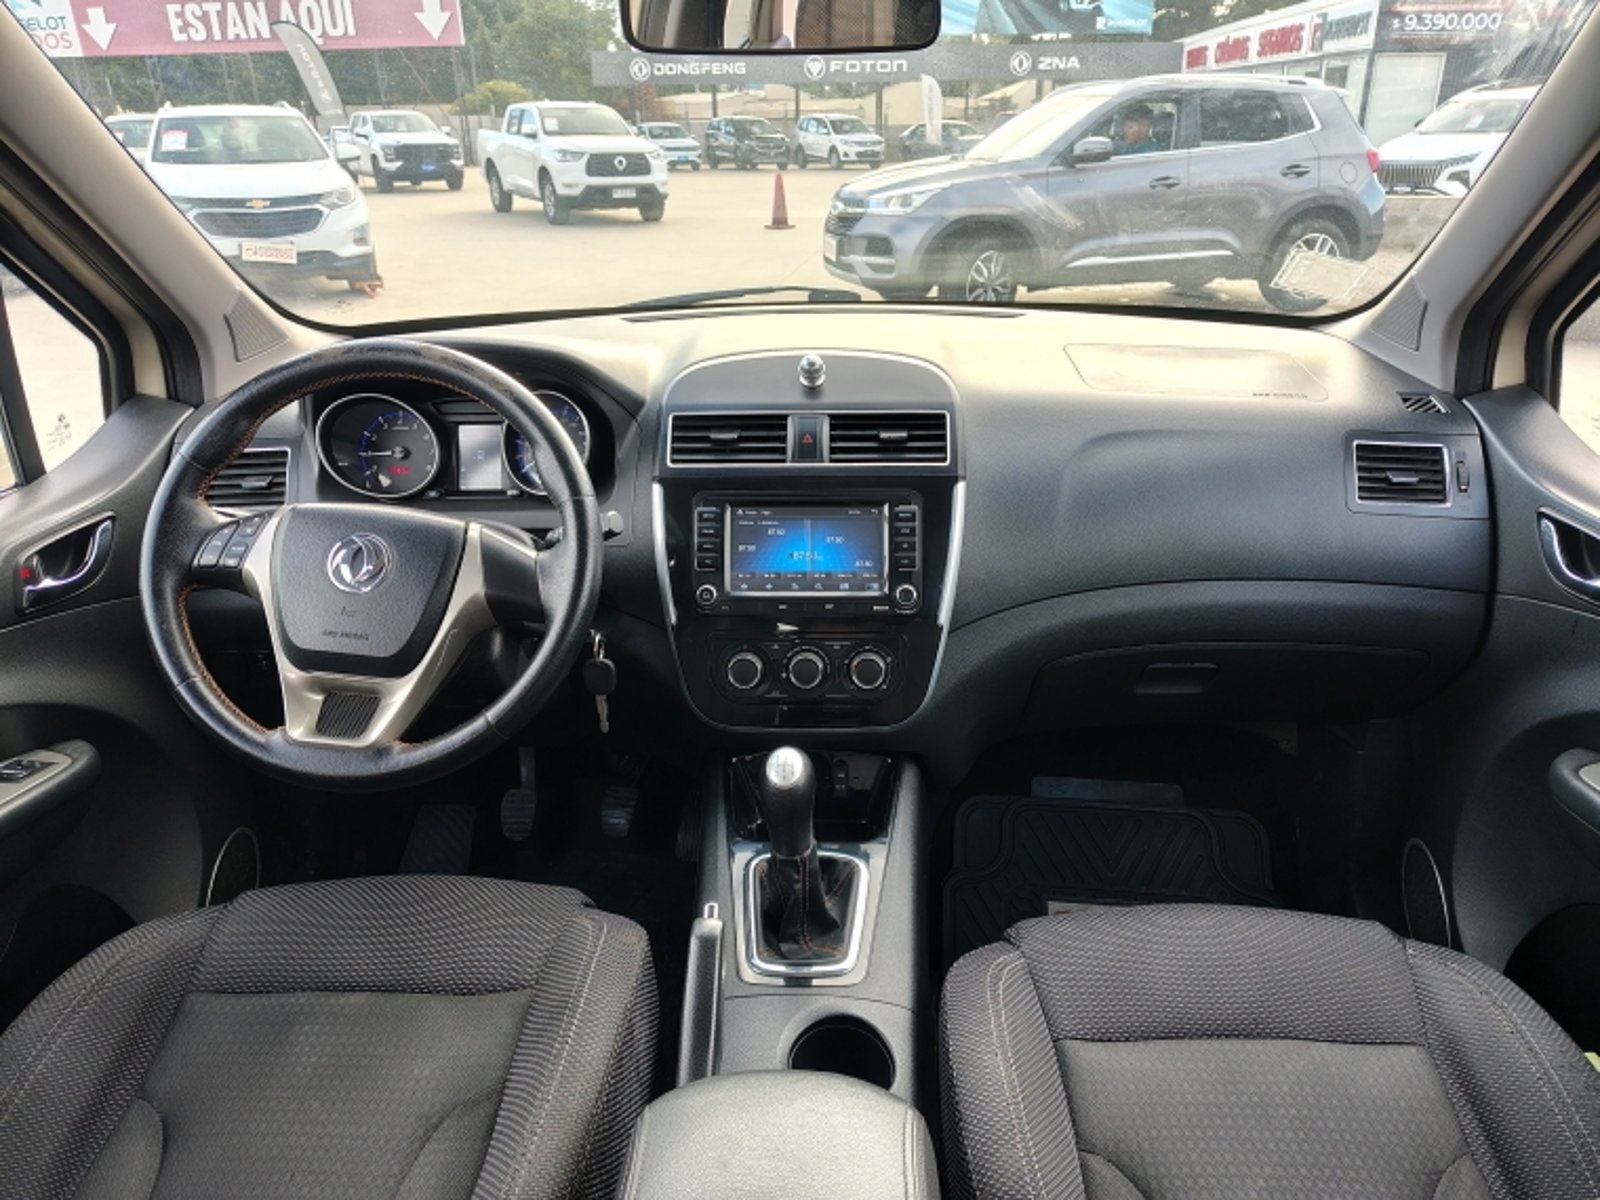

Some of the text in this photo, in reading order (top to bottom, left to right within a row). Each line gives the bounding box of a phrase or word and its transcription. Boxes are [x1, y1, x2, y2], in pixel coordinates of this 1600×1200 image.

[166, 0, 271, 42] ESTAN
[1404, 12, 1503, 31] 9.390.000
[653, 62, 746, 75] DONGFENG
[829, 60, 908, 72] FOTON
[1038, 56, 1080, 71] ZNA
